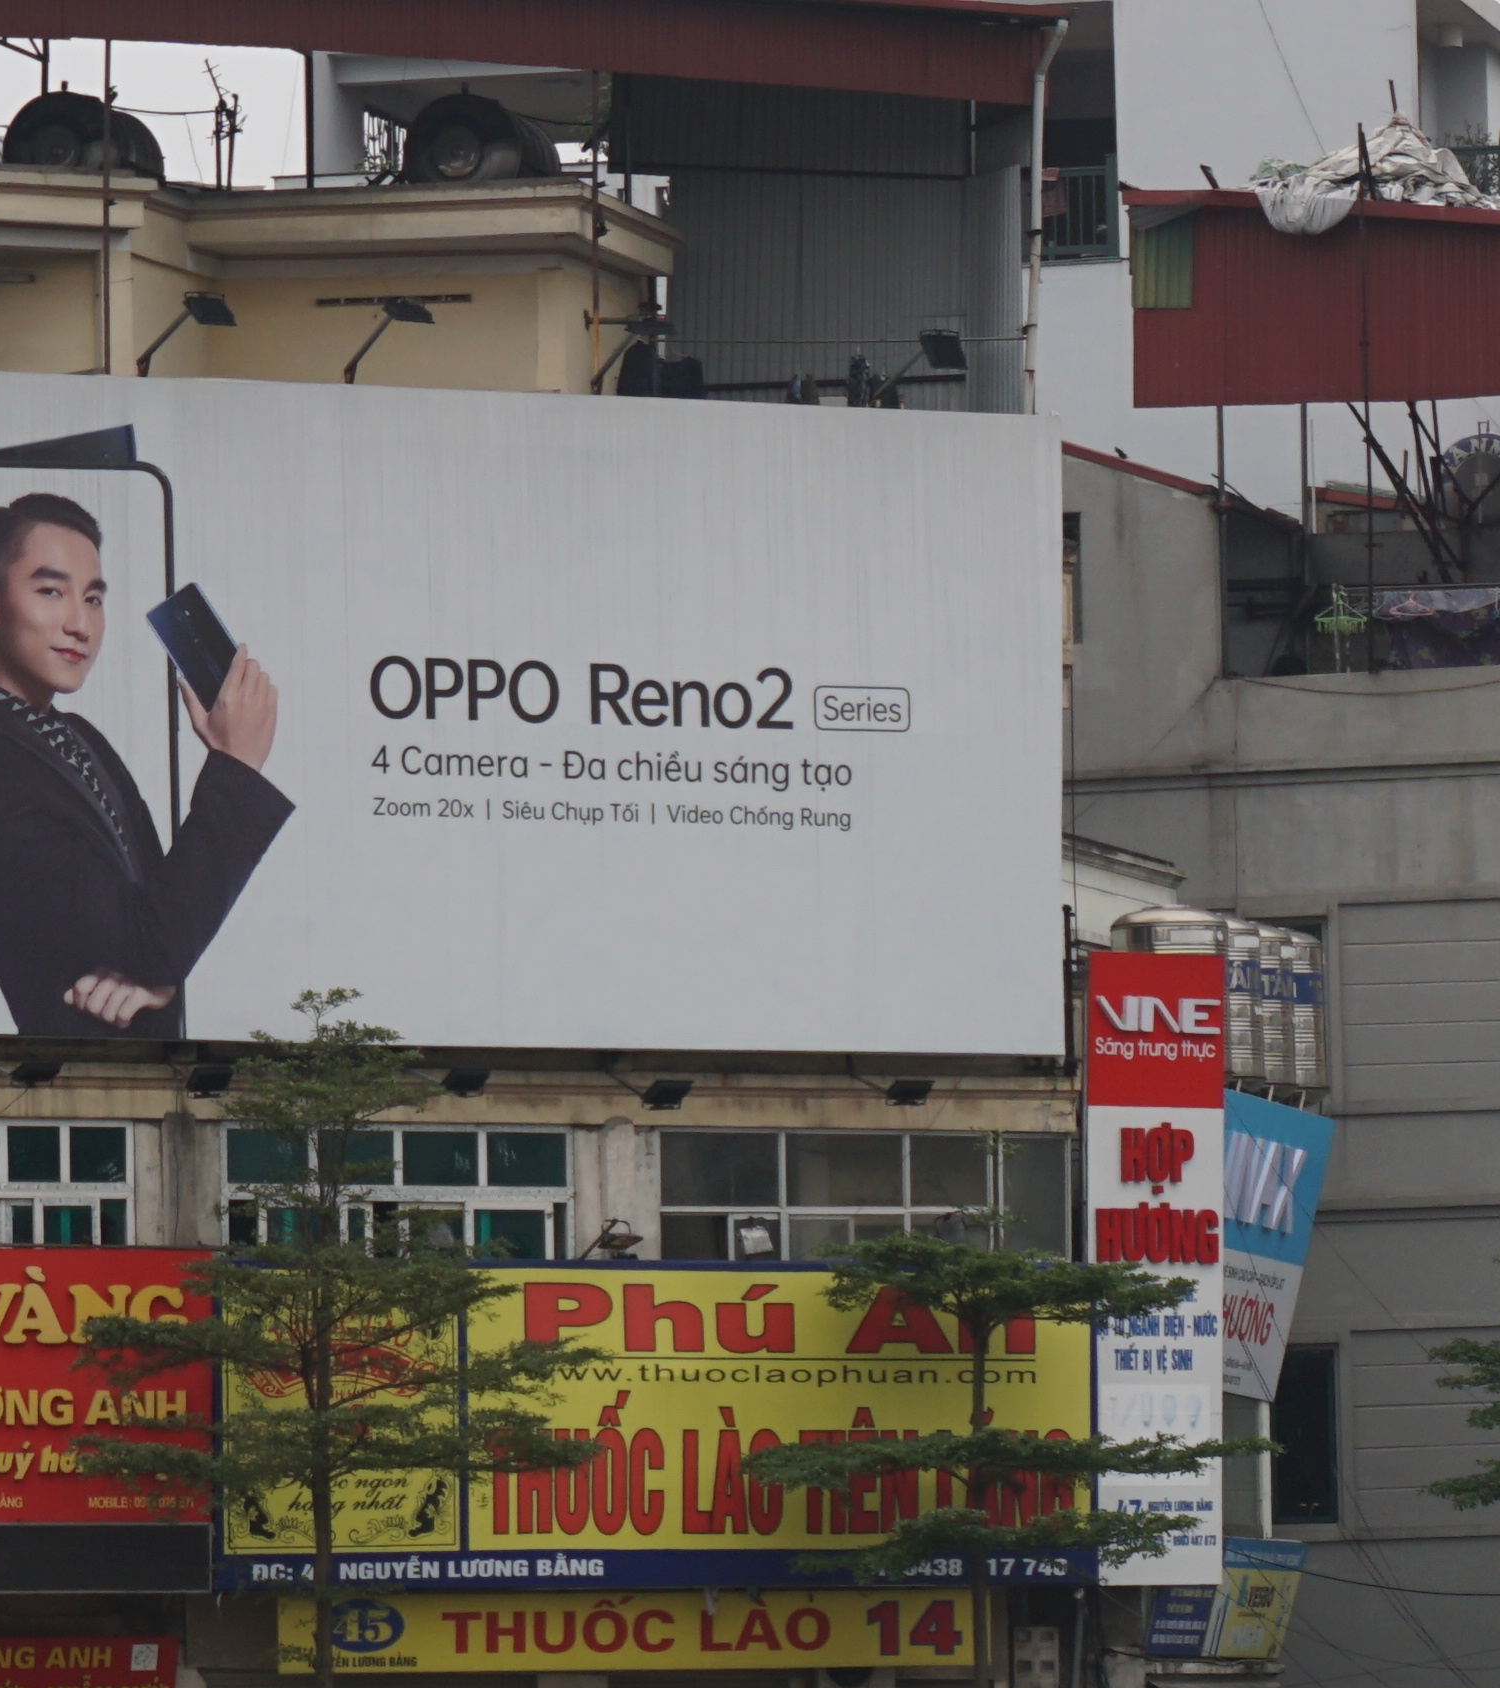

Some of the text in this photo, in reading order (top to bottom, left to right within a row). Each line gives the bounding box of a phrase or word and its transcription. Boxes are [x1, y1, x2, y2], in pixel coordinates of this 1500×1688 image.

[369, 655, 902, 730] OPPO Reno2 Series
[372, 745, 852, 792] 4 Camera Đa chiều sáng tạo
[373, 798, 852, 831] Zoom 20x Siêu Chụp Tối Video Chống Rung
[1095, 1037, 1216, 1062] Sáng trung thực
[1120, 1122, 1195, 1194] HỢP
[523, 1281, 1036, 1355] Phú An
[1171, 1349, 1193, 1371] SINH
[83, 1389, 187, 1426] ANH
[355, 1476, 409, 1495] ngon
[682, 1405, 784, 1535] LÀO
[353, 1492, 410, 1512] nhất
[340, 1555, 439, 1580] NGUYỄN
[448, 1559, 529, 1578] LƯƠNG
[537, 1552, 604, 1577] BẰNG
[334, 1608, 394, 1644] 45
[441, 1596, 963, 1656] THUỐC LÀO 14
[45, 1647, 113, 1669] ANH
